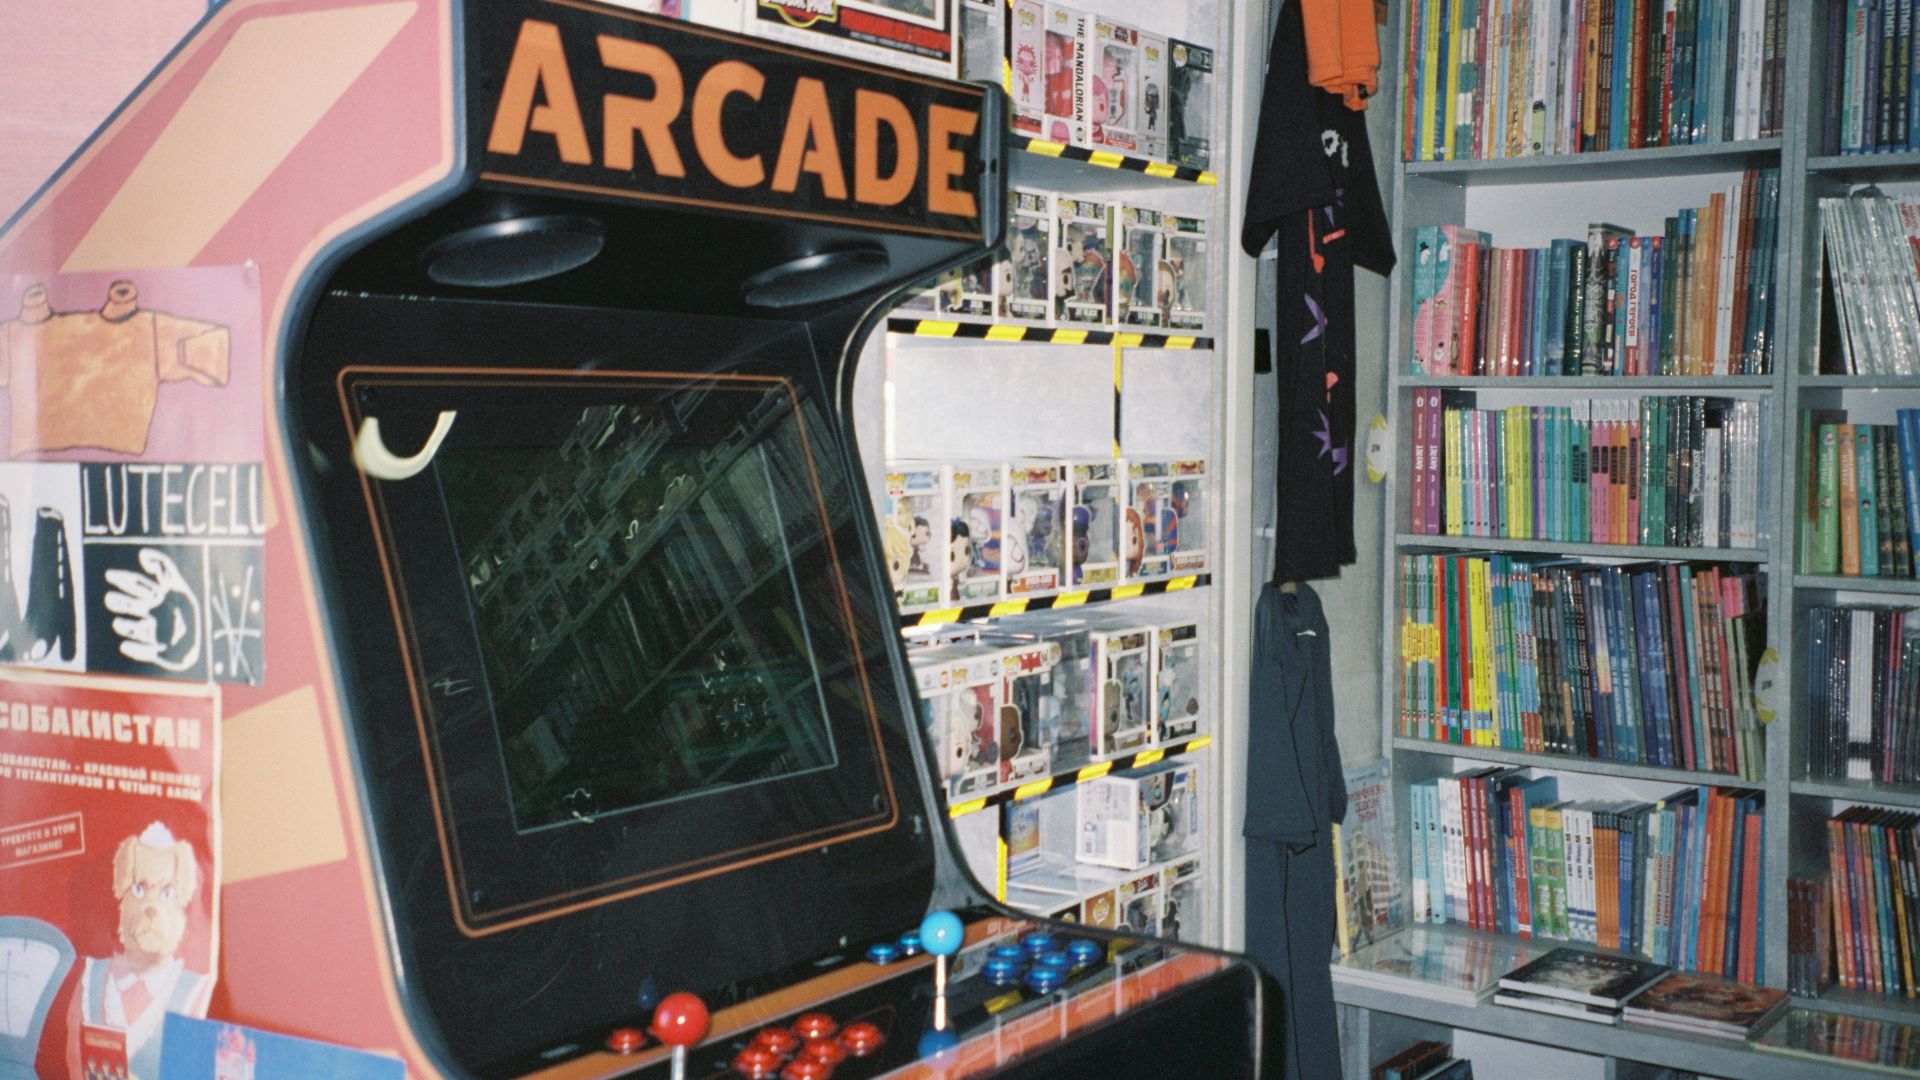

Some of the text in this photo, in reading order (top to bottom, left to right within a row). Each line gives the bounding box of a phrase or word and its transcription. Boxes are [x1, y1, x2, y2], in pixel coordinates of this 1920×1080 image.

[1075, 17, 1085, 121] THE MANDALORIAN
[487, 19, 979, 218] ARCADE
[1630, 269, 1638, 300] ГОРОД
[16, 768, 103, 790] ТОТАЛИТАРИЗМ
[119, 780, 163, 797] ЧЕТЫРЕ
[84, 762, 147, 781] КРАСИВЫЙ
